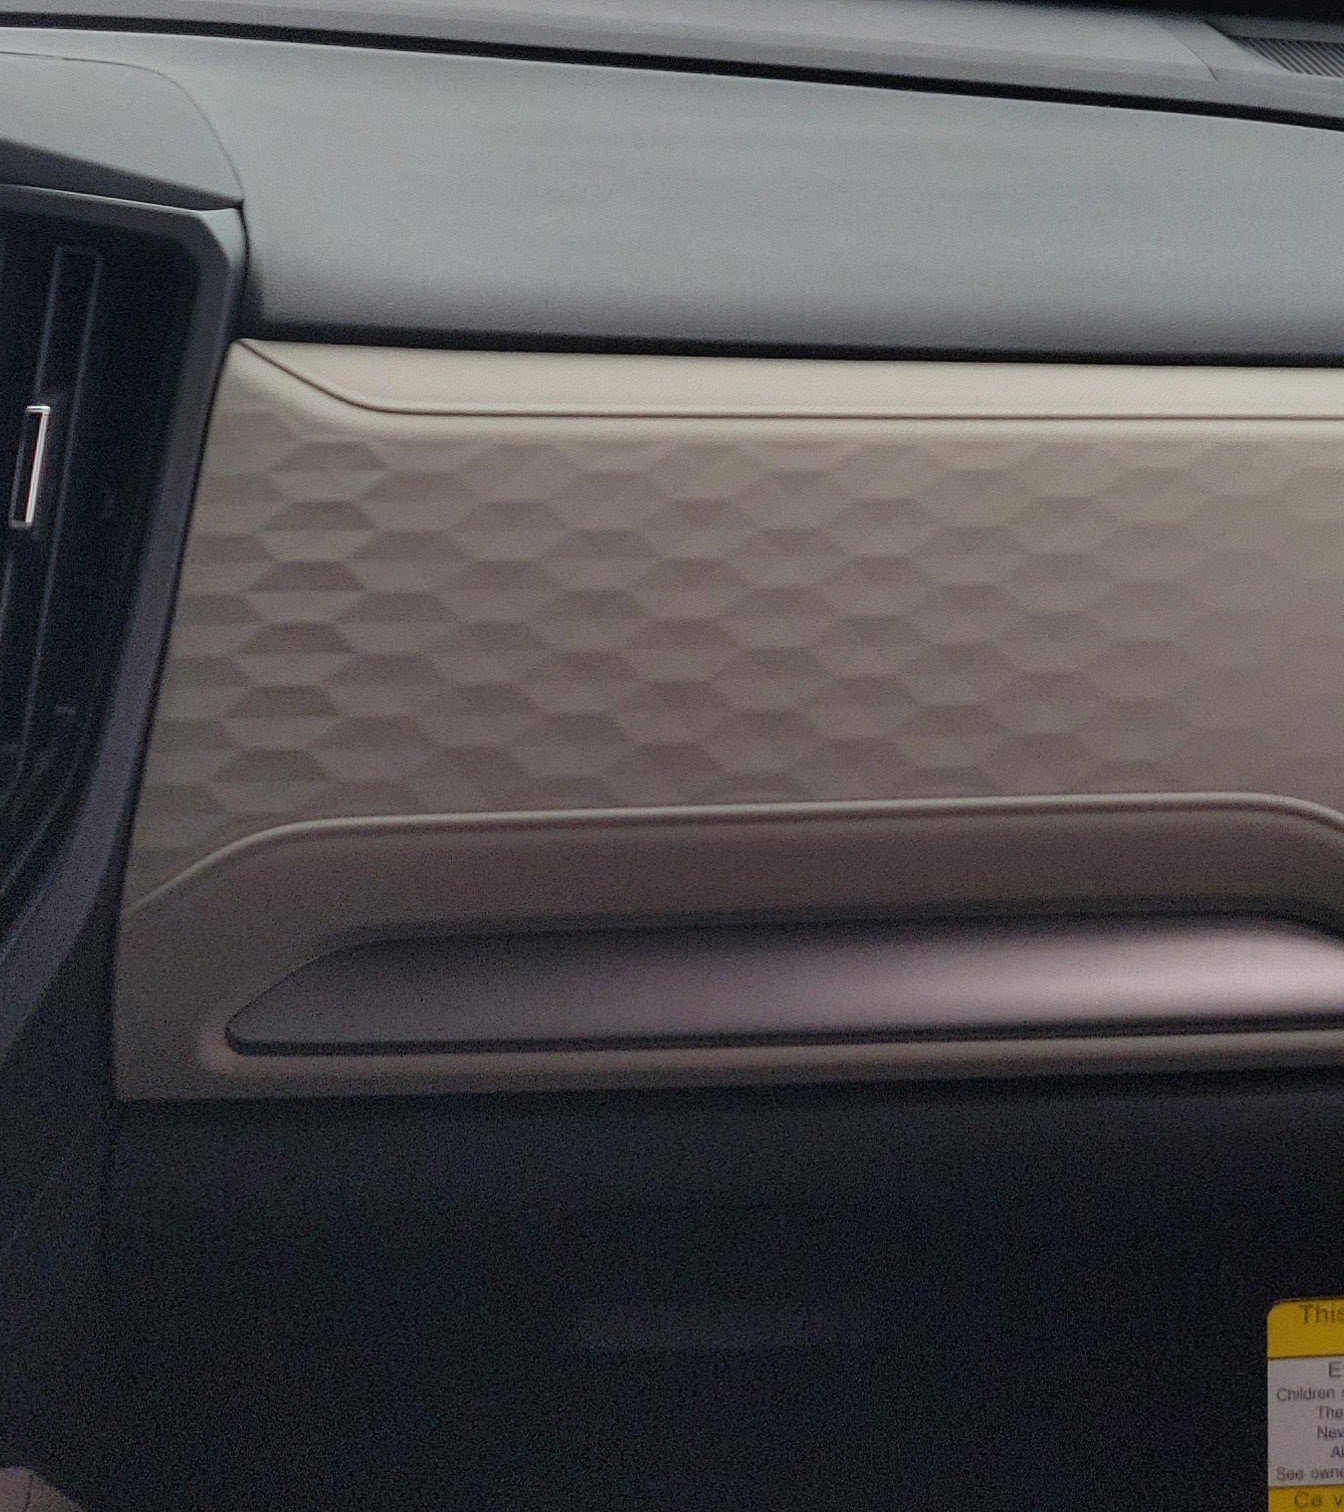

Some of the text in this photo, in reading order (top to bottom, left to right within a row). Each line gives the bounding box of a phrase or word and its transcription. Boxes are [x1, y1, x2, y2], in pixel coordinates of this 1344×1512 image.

[1276, 1385, 1336, 1402] Children
[1317, 1405, 1344, 1419] The
[1276, 1466, 1304, 1481] See
[1294, 1490, 1323, 1508] Ce
